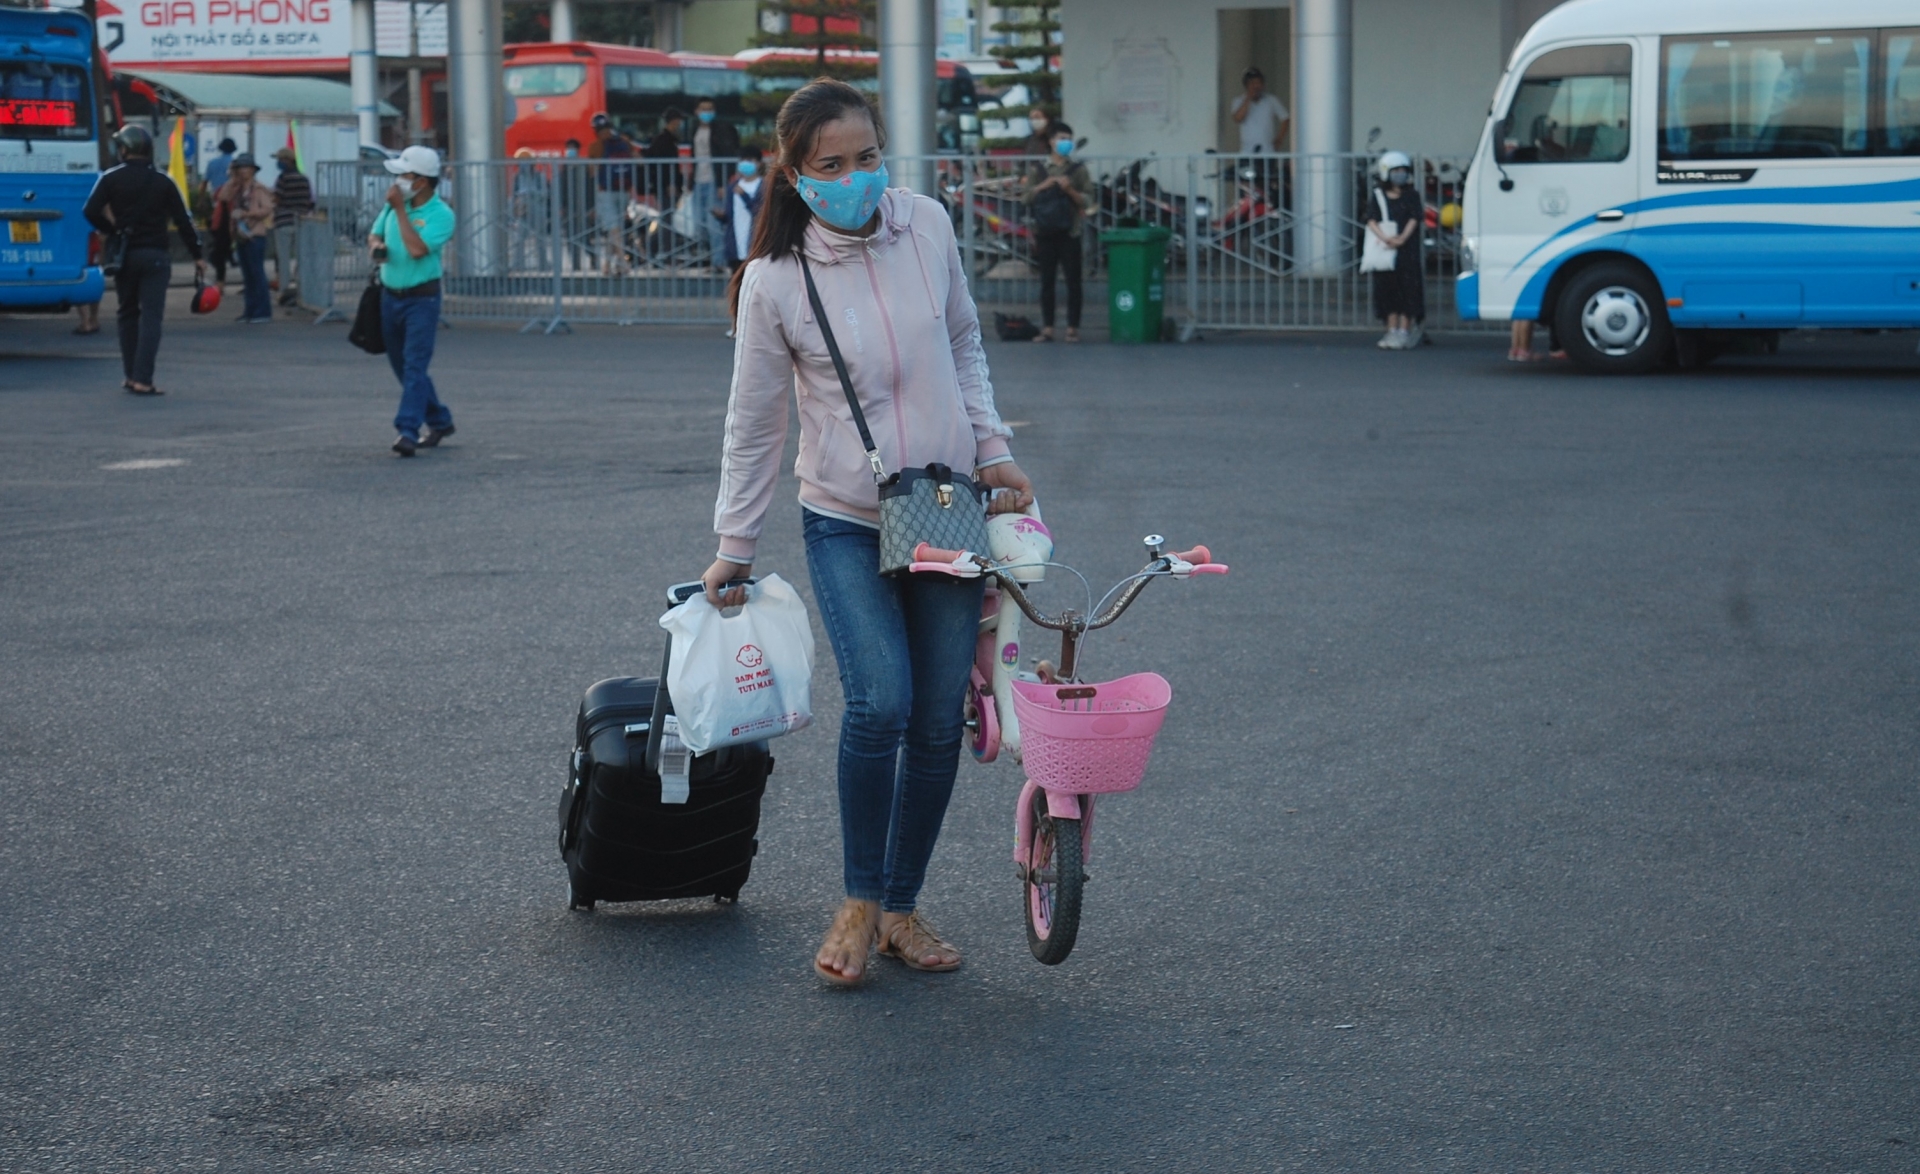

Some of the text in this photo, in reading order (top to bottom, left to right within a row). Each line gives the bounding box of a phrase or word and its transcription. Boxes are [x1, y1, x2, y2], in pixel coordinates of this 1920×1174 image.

[141, 0, 331, 27] GIA PHONG
[274, 31, 320, 46] SOFA
[735, 673, 754, 684] BABY
[738, 683, 756, 694] TUTI
